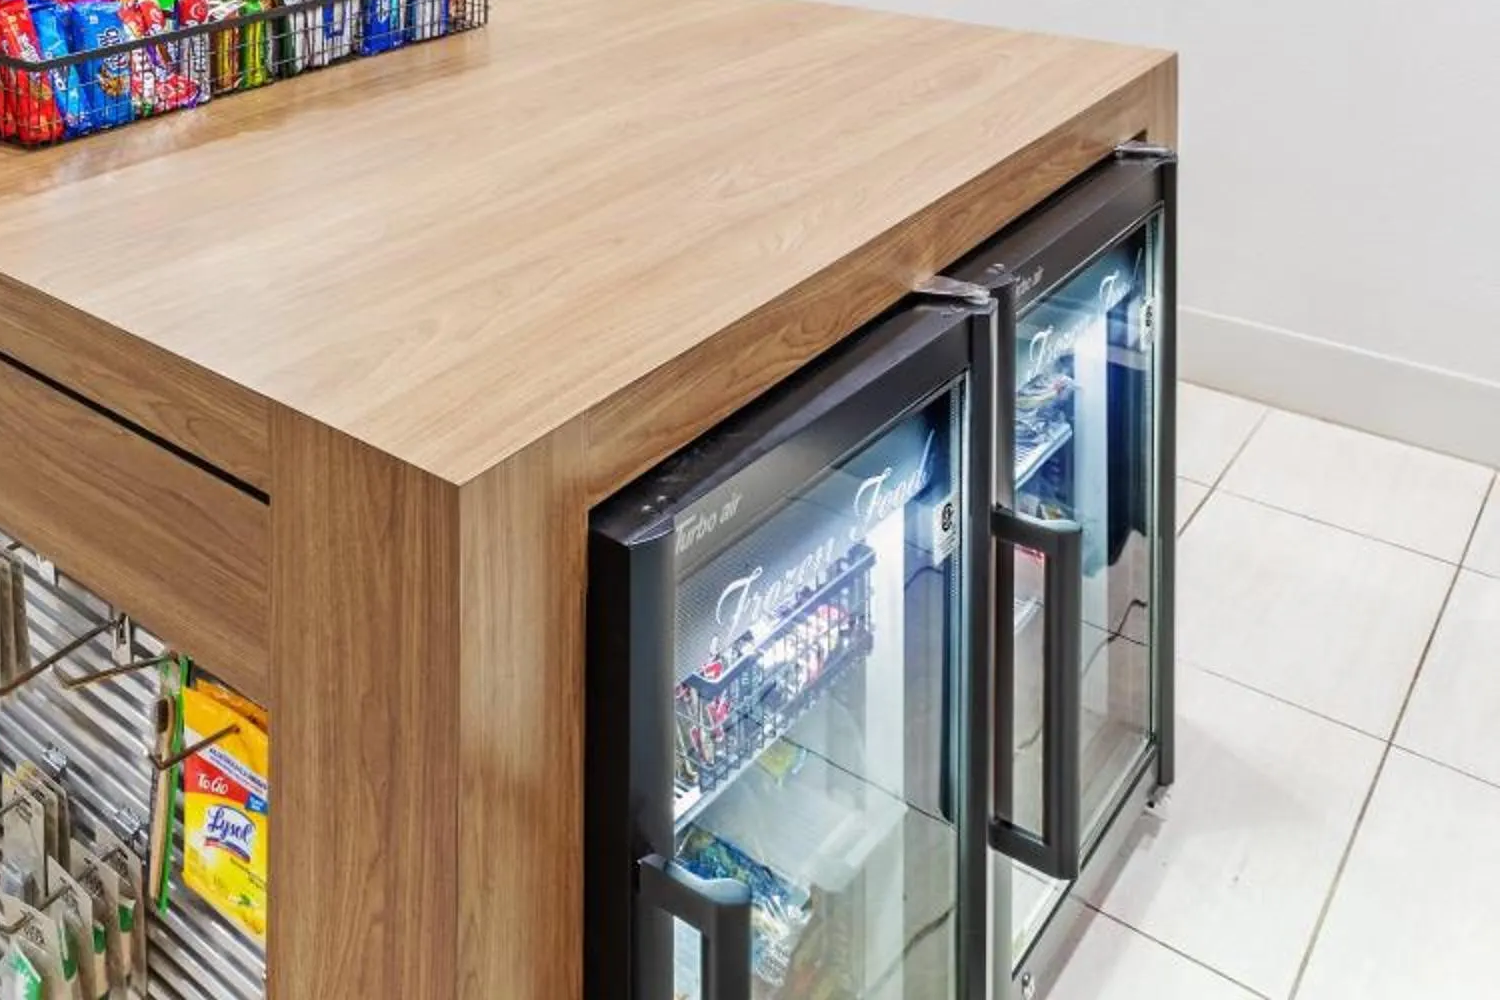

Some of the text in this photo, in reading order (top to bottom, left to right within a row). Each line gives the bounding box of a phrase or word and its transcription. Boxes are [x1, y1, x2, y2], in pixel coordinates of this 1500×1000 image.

[674, 514, 716, 555] Turbo
[197, 772, 229, 796] To Go
[208, 808, 251, 842] Lysol
